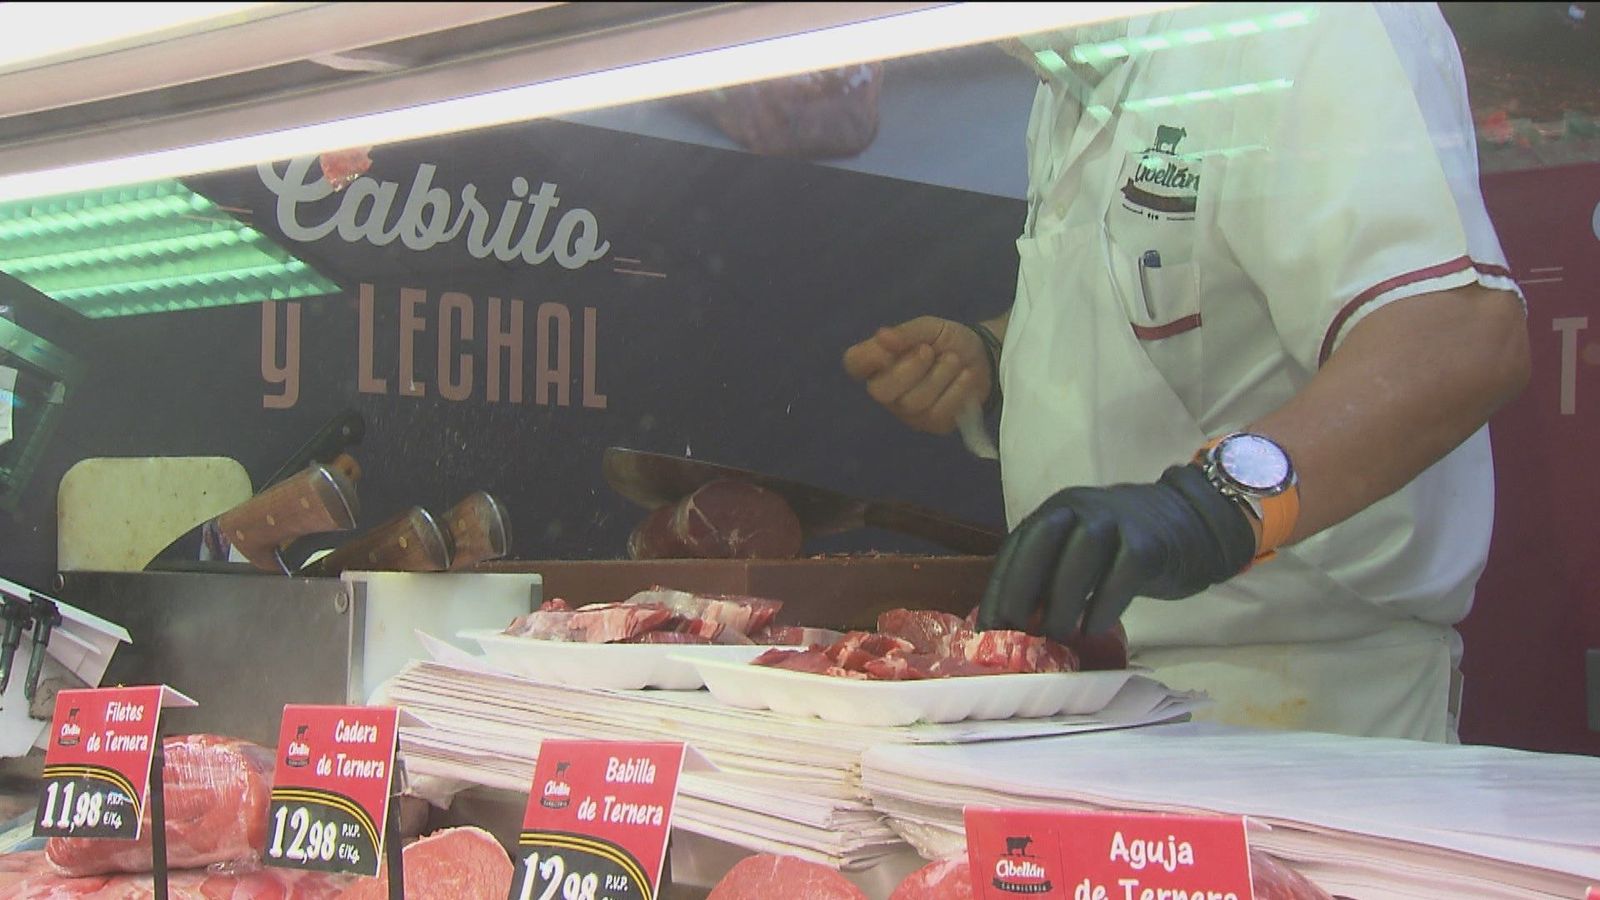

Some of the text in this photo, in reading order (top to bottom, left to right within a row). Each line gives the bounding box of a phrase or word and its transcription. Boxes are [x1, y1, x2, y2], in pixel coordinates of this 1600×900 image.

[257, 155, 610, 270] Cabrito
[358, 282, 607, 409] LECHAL
[105, 701, 144, 722] Filetes
[86, 731, 100, 753] de
[104, 730, 148, 752] Ternera
[335, 718, 378, 743] Cadera
[316, 753, 332, 777] de
[336, 753, 385, 778] Ternera
[605, 756, 657, 785] Babilla
[41, 781, 103, 833] 11,98
[577, 795, 664, 826] de Ternera
[269, 804, 338, 864] 12,98
[1110, 831, 1195, 873] Aguja
[519, 851, 599, 900] 1298
[604, 874, 629, 891] P.V.P.
[1074, 878, 1109, 900] de
